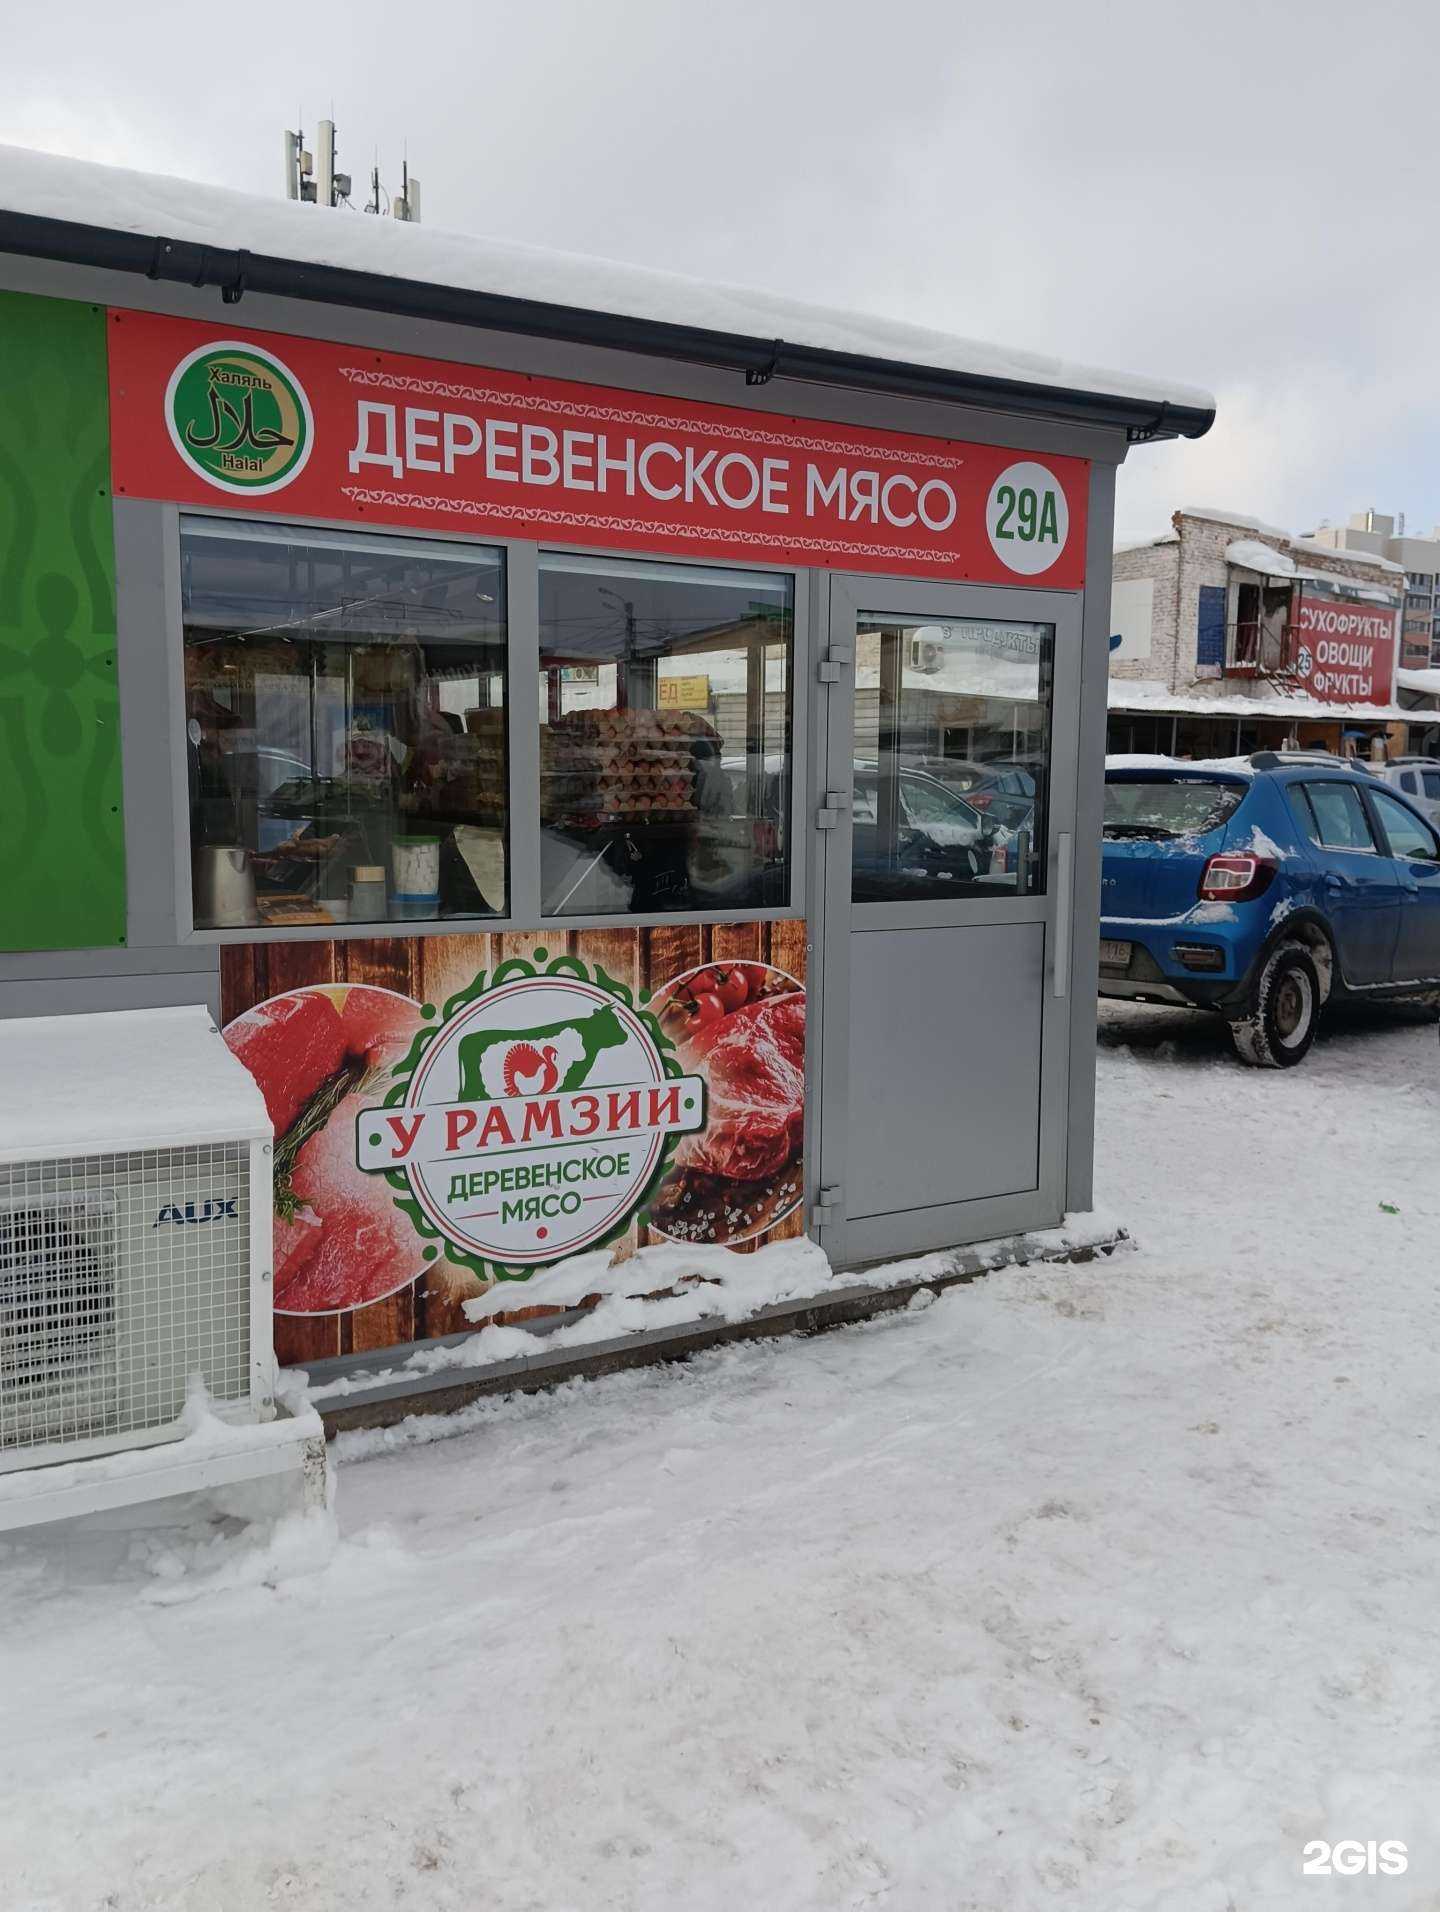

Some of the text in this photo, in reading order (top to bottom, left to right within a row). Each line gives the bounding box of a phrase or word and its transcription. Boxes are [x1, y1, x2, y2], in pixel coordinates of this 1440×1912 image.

[209, 366, 273, 390] Халяль
[221, 454, 264, 472] Halal
[349, 399, 957, 532] ДЕРЕВЕНСКОЕ МЯСО
[995, 485, 1059, 544] 29А
[1300, 607, 1392, 640] СУХОФРУКТЫ
[1298, 653, 1312, 670] 25
[1316, 640, 1374, 671] ОВОЩИ
[1313, 671, 1373, 696] ФРУКТЫ
[386, 1086, 682, 1159] У РАМЗИИ
[447, 1152, 631, 1204] ДЕРЕВЕНСКОЕ
[152, 1196, 239, 1228] AUX
[501, 1190, 582, 1225] МЯСО
